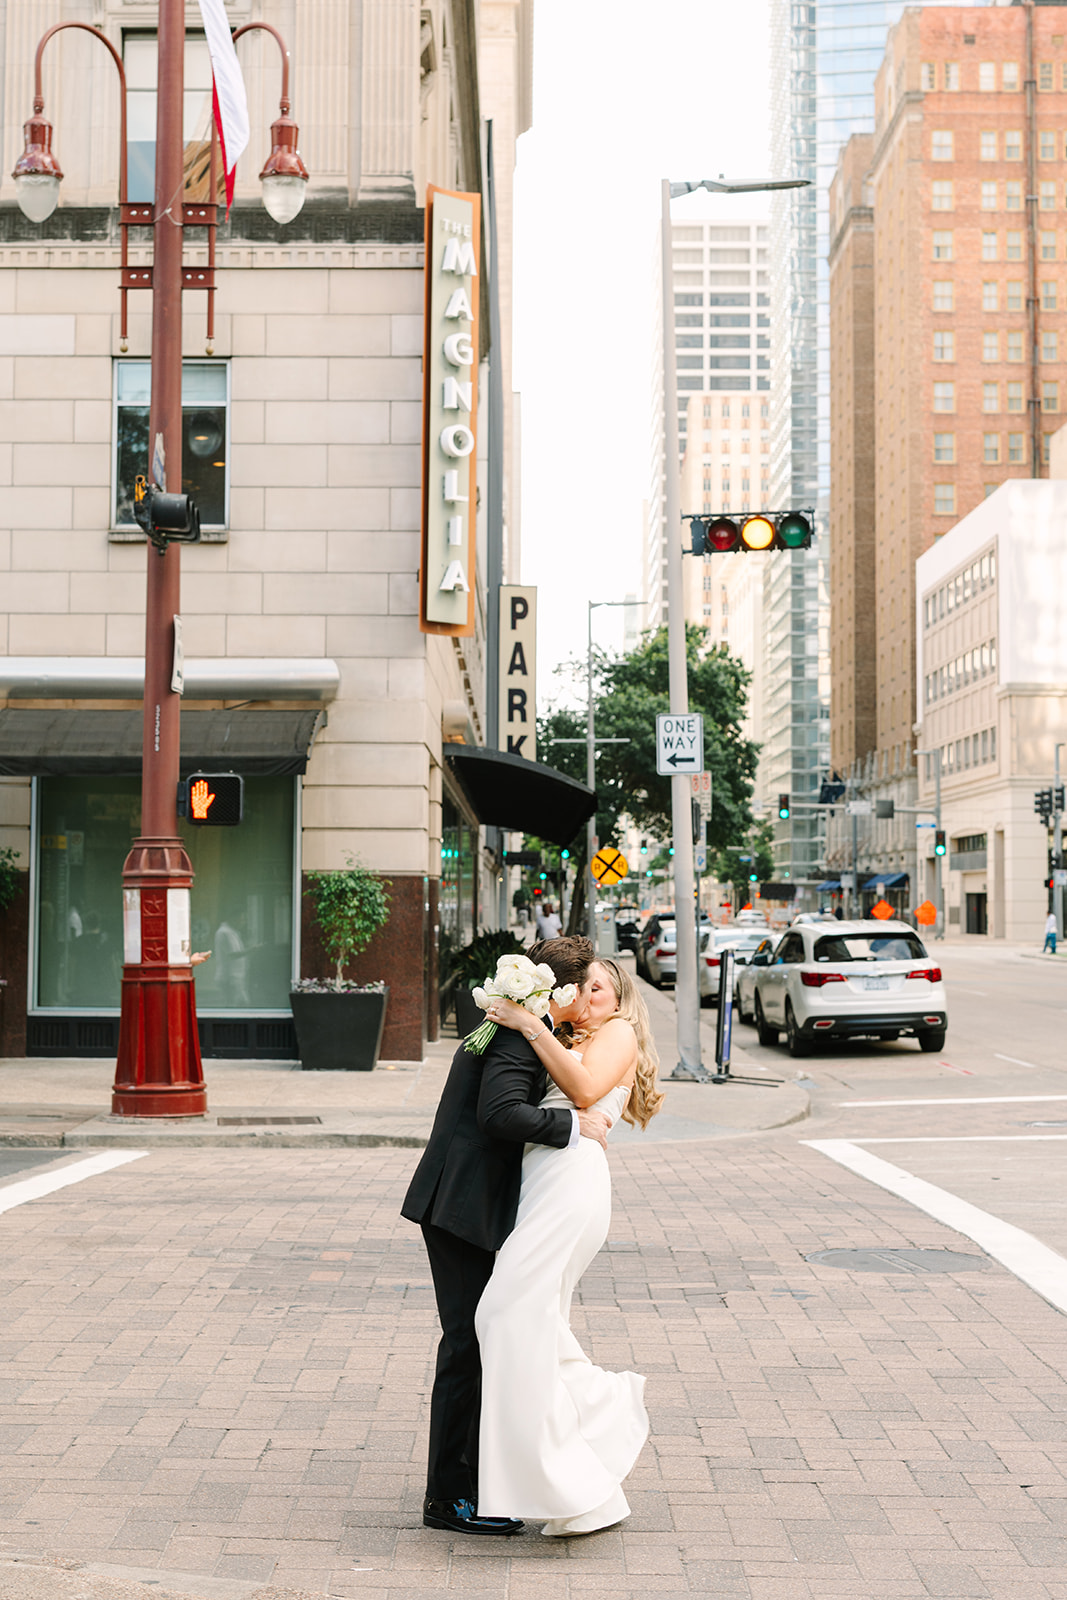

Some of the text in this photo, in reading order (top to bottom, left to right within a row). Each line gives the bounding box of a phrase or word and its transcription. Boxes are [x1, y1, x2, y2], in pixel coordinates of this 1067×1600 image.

[442, 218, 471, 237] THE
[440, 237, 477, 592] MAGNOLIA
[507, 596, 529, 758] PARK
[663, 719, 696, 733] ONE
[662, 736, 697, 749] WAY
